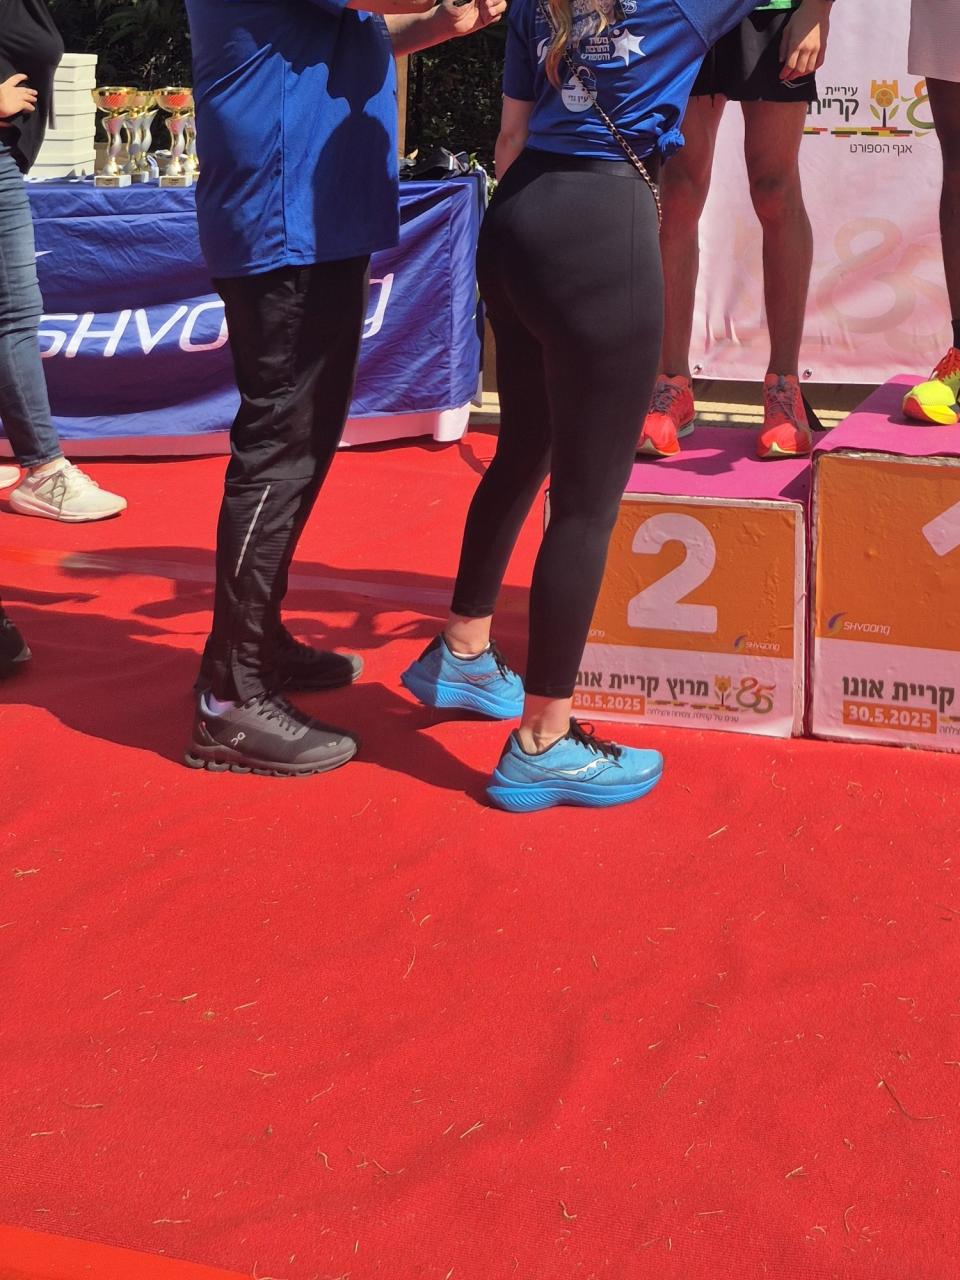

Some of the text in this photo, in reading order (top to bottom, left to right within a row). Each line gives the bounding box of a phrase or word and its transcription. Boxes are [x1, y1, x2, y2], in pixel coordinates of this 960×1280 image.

[825, 86, 858, 96] עיריית
[849, 143, 912, 157] אגף הספורט
[626, 513, 718, 634] 2
[608, 672, 660, 698] קריית
[666, 677, 709, 700] מרוץ
[842, 675, 884, 699] אונו
[891, 680, 955, 713] קריית
[573, 692, 641, 711] 30.5.2025
[848, 704, 932, 729] 30.5.2025
